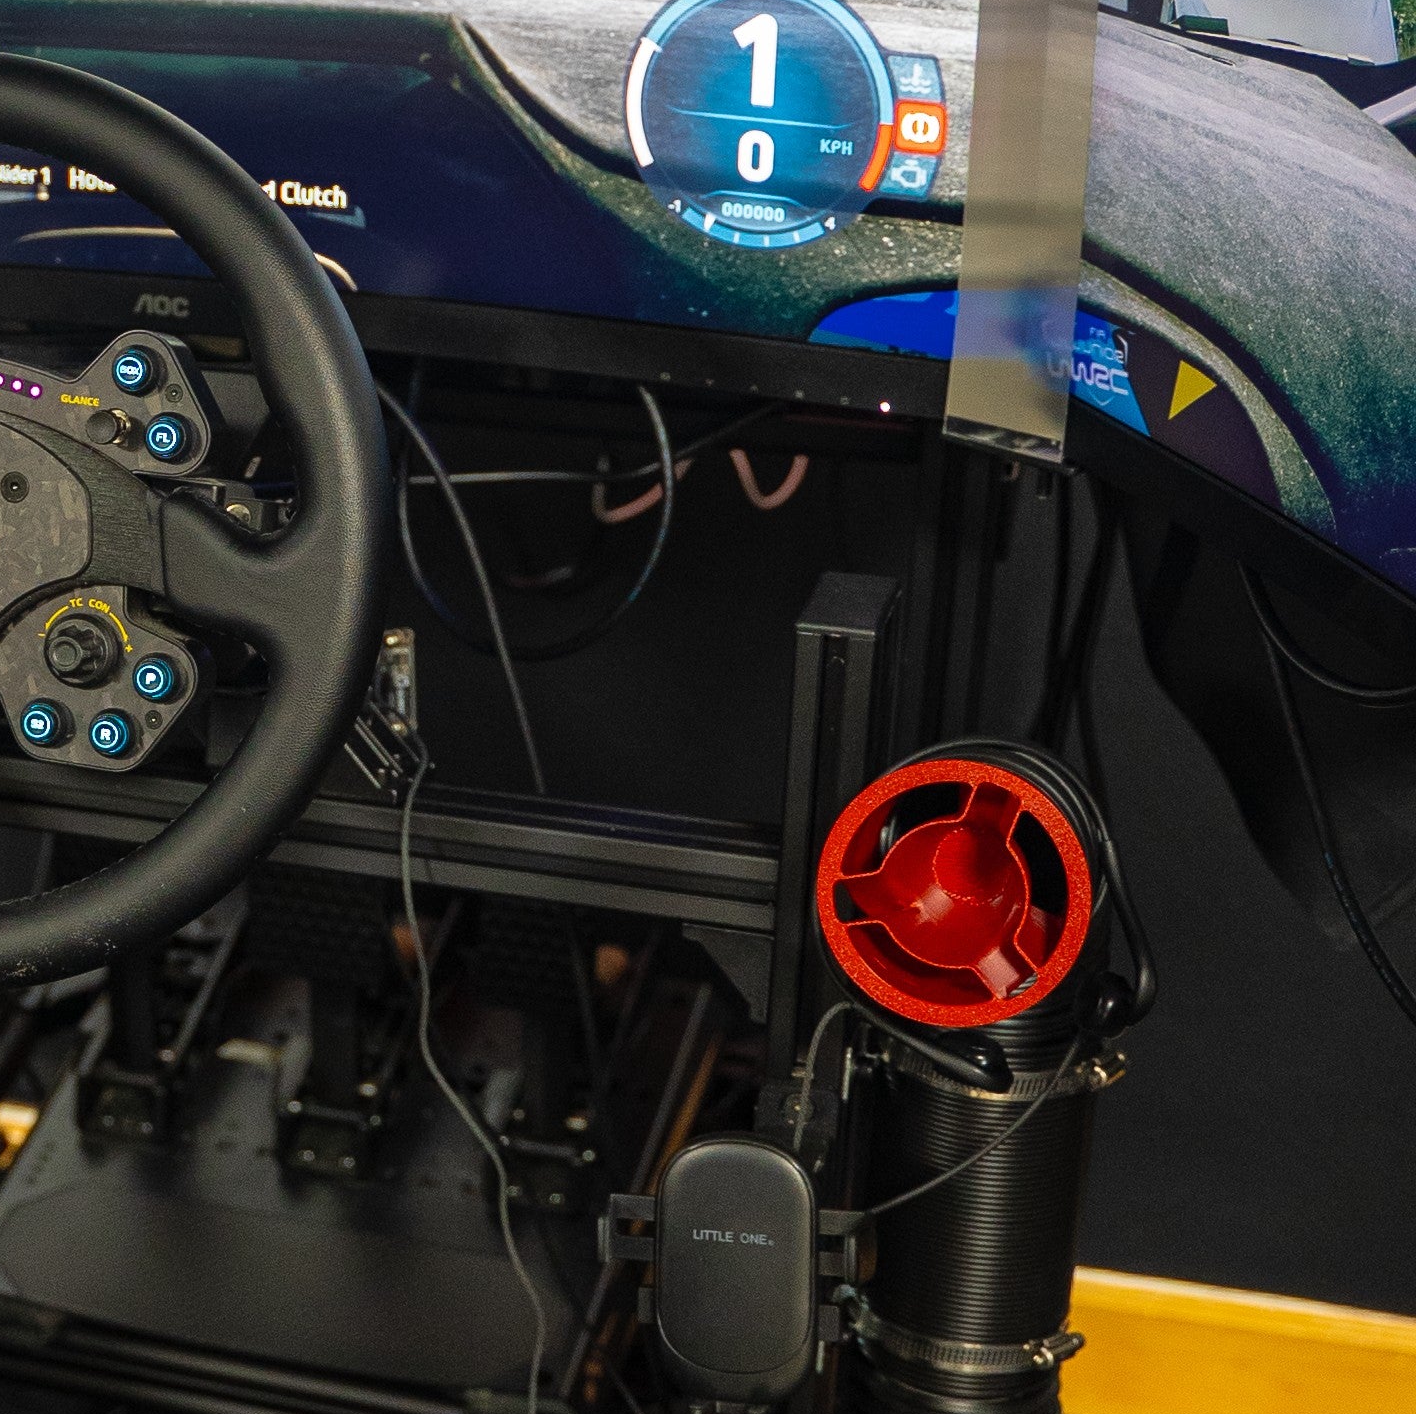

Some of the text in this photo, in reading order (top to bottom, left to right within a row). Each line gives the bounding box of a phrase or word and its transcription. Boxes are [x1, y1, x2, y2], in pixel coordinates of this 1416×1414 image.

[733, 13, 778, 107] 1
[737, 129, 853, 183] 0 KPH
[280, 181, 348, 208] Clutch
[721, 201, 785, 222] 000000
[133, 293, 190, 318] AOC
[60, 394, 100, 407] GLANCE
[69, 598, 111, 614] TC CON
[145, 672, 157, 685] P
[99, 727, 112, 741] R
[692, 1229, 735, 1243] LITTLE
